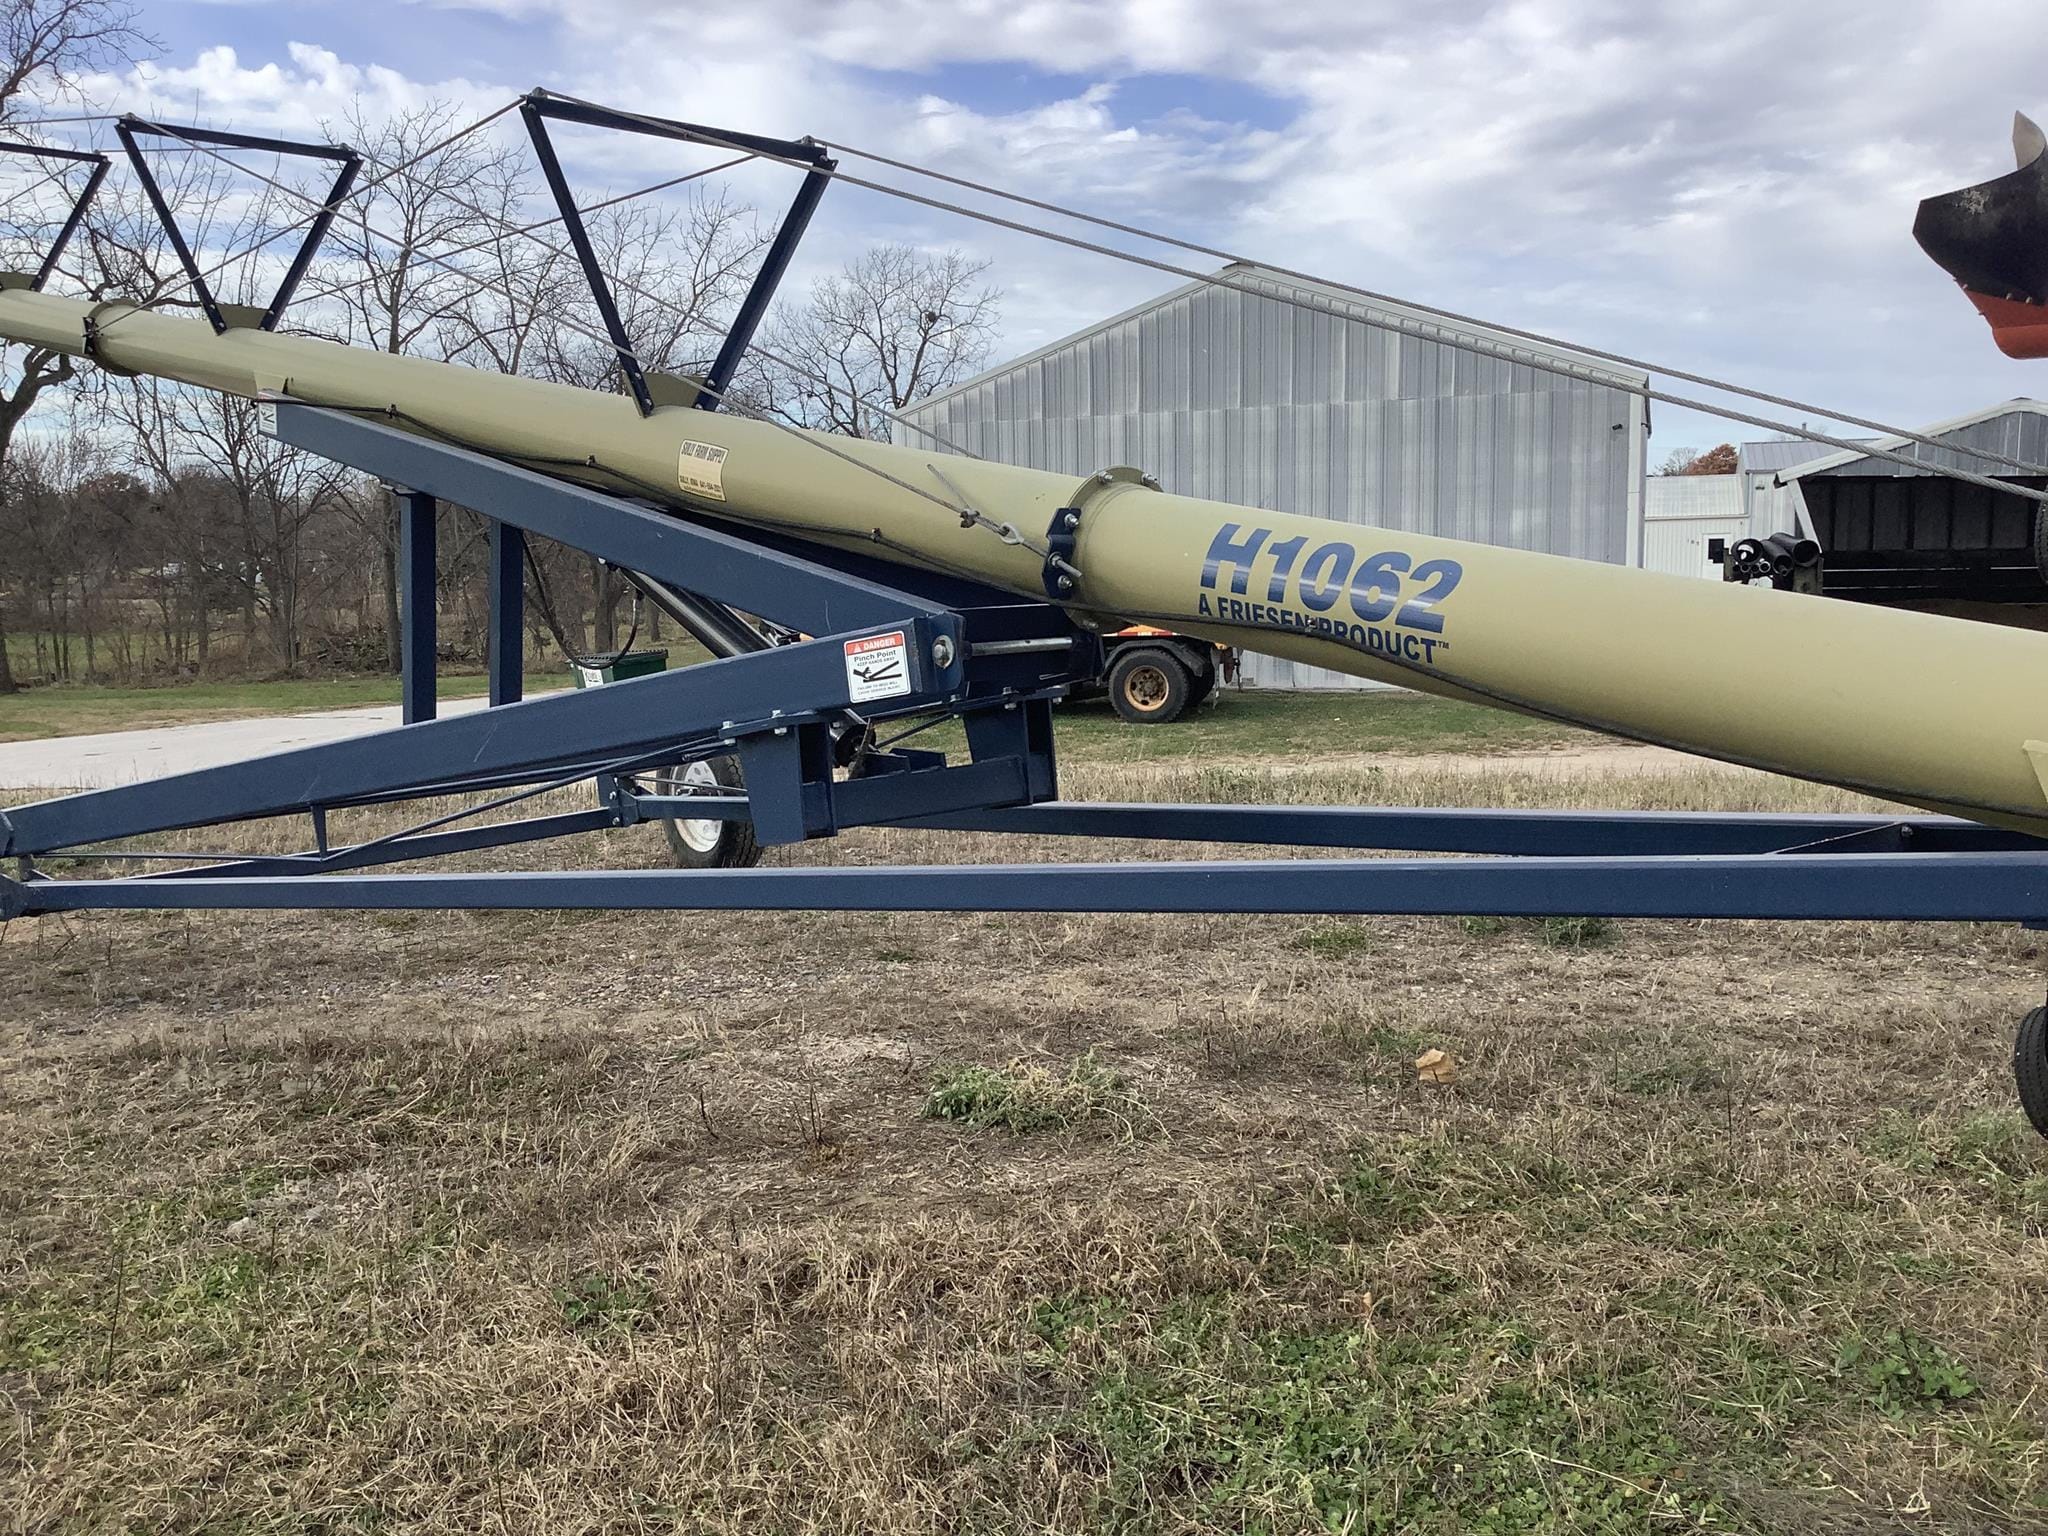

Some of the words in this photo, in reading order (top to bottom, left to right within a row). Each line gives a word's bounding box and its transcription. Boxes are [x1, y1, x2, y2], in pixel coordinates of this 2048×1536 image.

[1200, 523, 1463, 634] H1062
[1199, 593, 1212, 617] A
[1217, 596, 1312, 627] FRIESEN
[854, 654, 875, 662] Pinch
[876, 650, 896, 658] Point
[863, 638, 896, 651] DANGER
